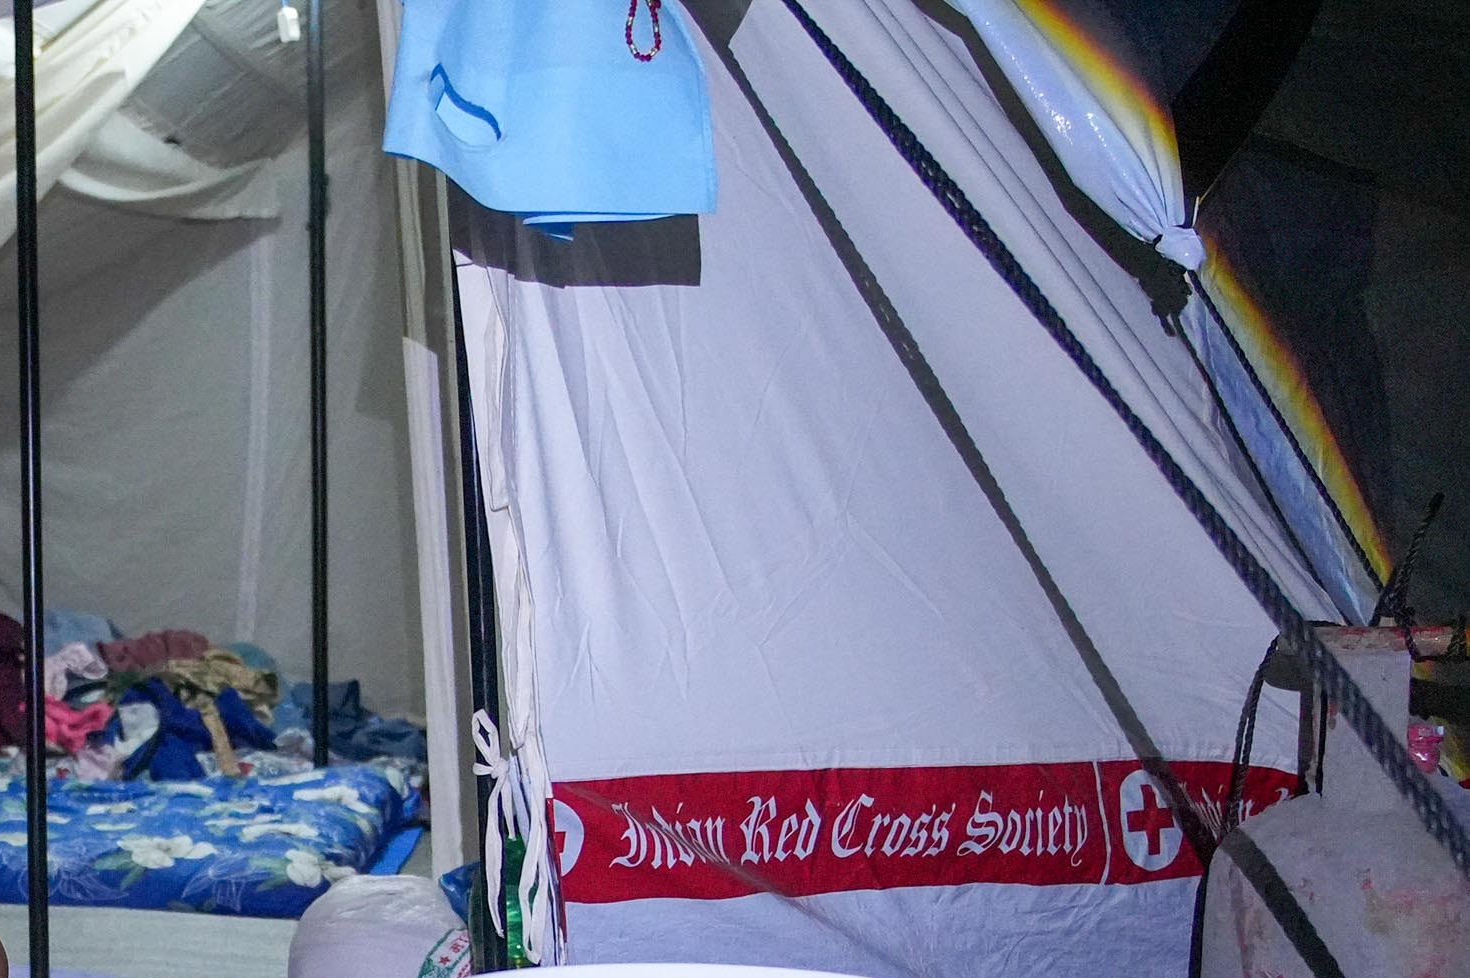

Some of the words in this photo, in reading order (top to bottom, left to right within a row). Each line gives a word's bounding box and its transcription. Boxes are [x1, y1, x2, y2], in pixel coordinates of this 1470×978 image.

[609, 802, 730, 869] Indian
[739, 795, 822, 866] Red
[831, 793, 956, 858] Cross
[956, 789, 1088, 867] Society
